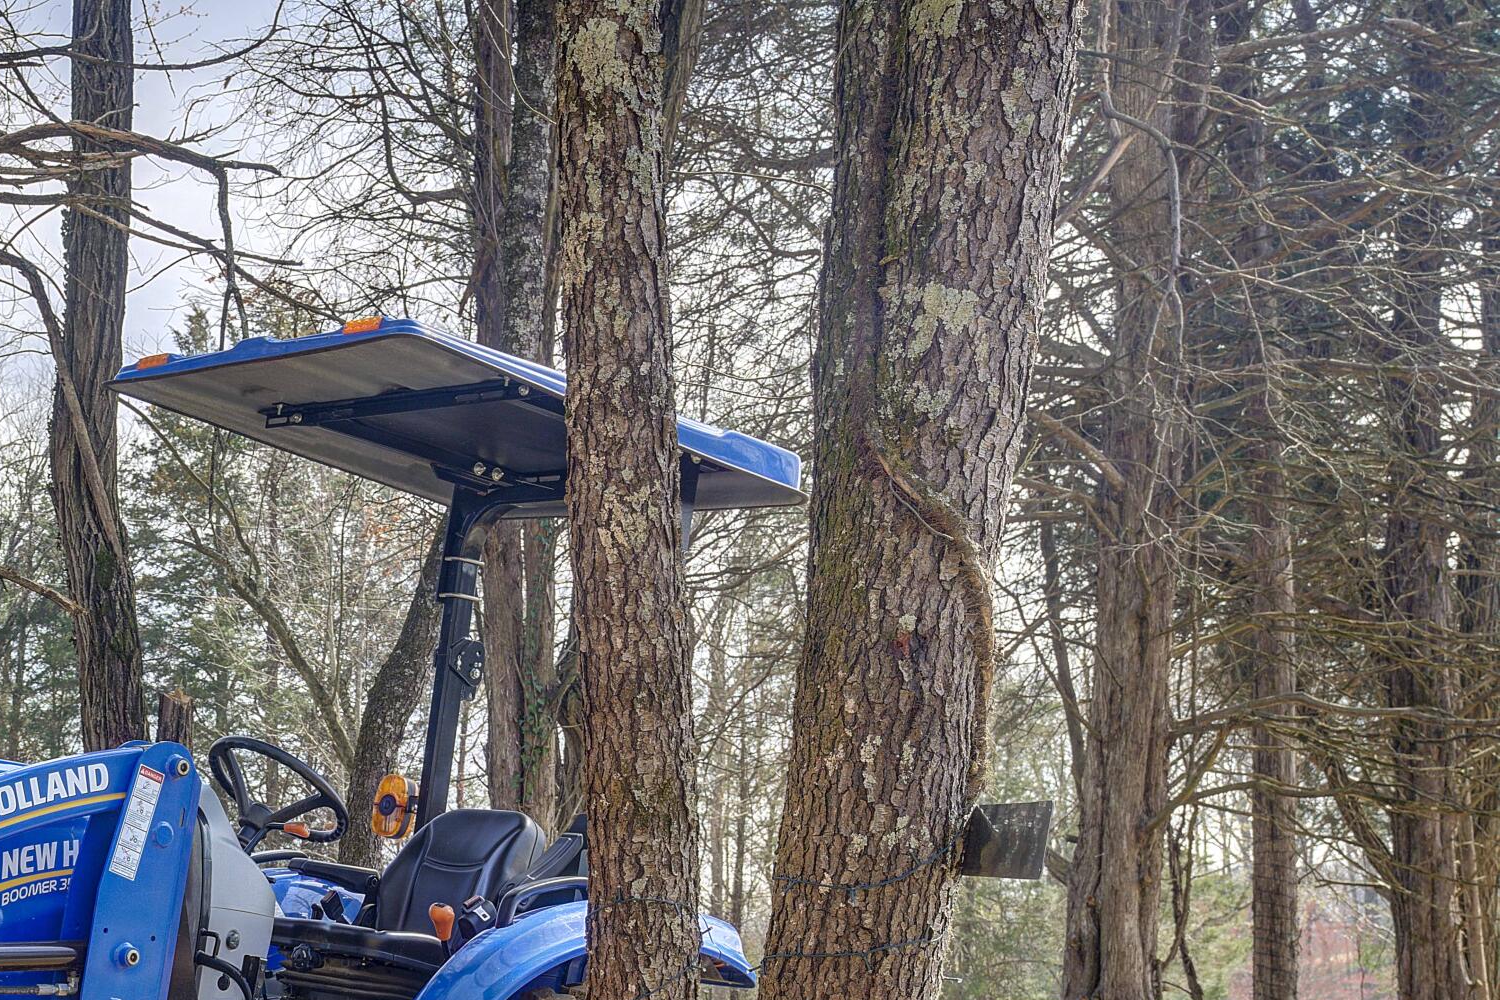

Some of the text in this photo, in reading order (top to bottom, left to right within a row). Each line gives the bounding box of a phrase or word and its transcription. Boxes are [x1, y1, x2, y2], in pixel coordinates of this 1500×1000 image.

[1, 839, 80, 879] NEW H
[1, 881, 58, 906] BOOMER
